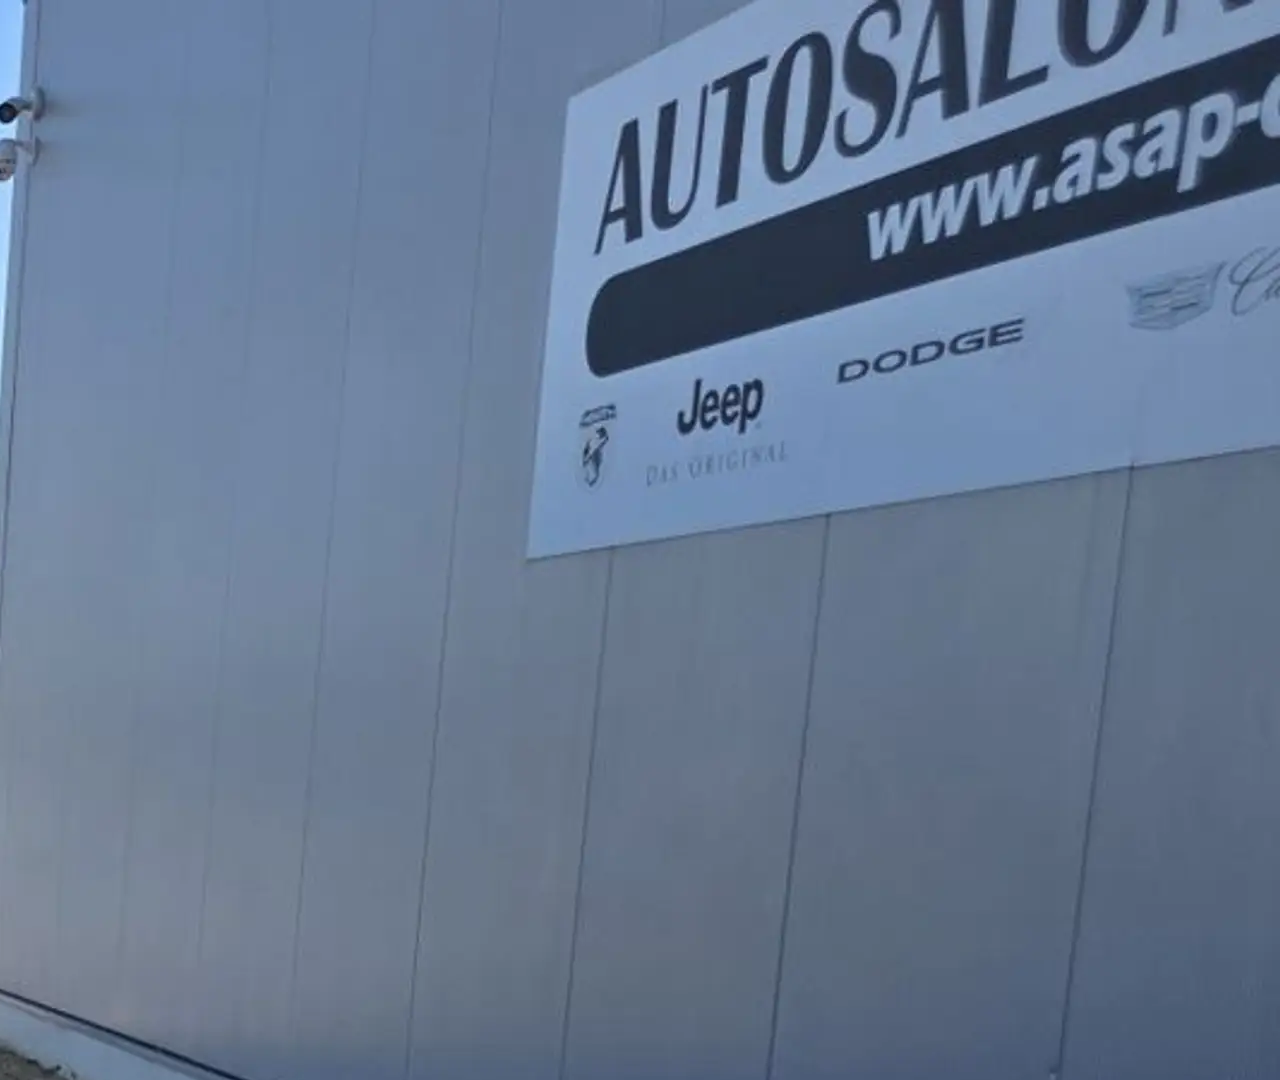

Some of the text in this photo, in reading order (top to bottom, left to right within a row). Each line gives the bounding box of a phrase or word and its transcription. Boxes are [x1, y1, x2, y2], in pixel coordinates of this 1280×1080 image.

[595, 0, 1254, 254] AUTOSAL
[836, 318, 1026, 385] DODGE
[676, 376, 765, 435] Jeep
